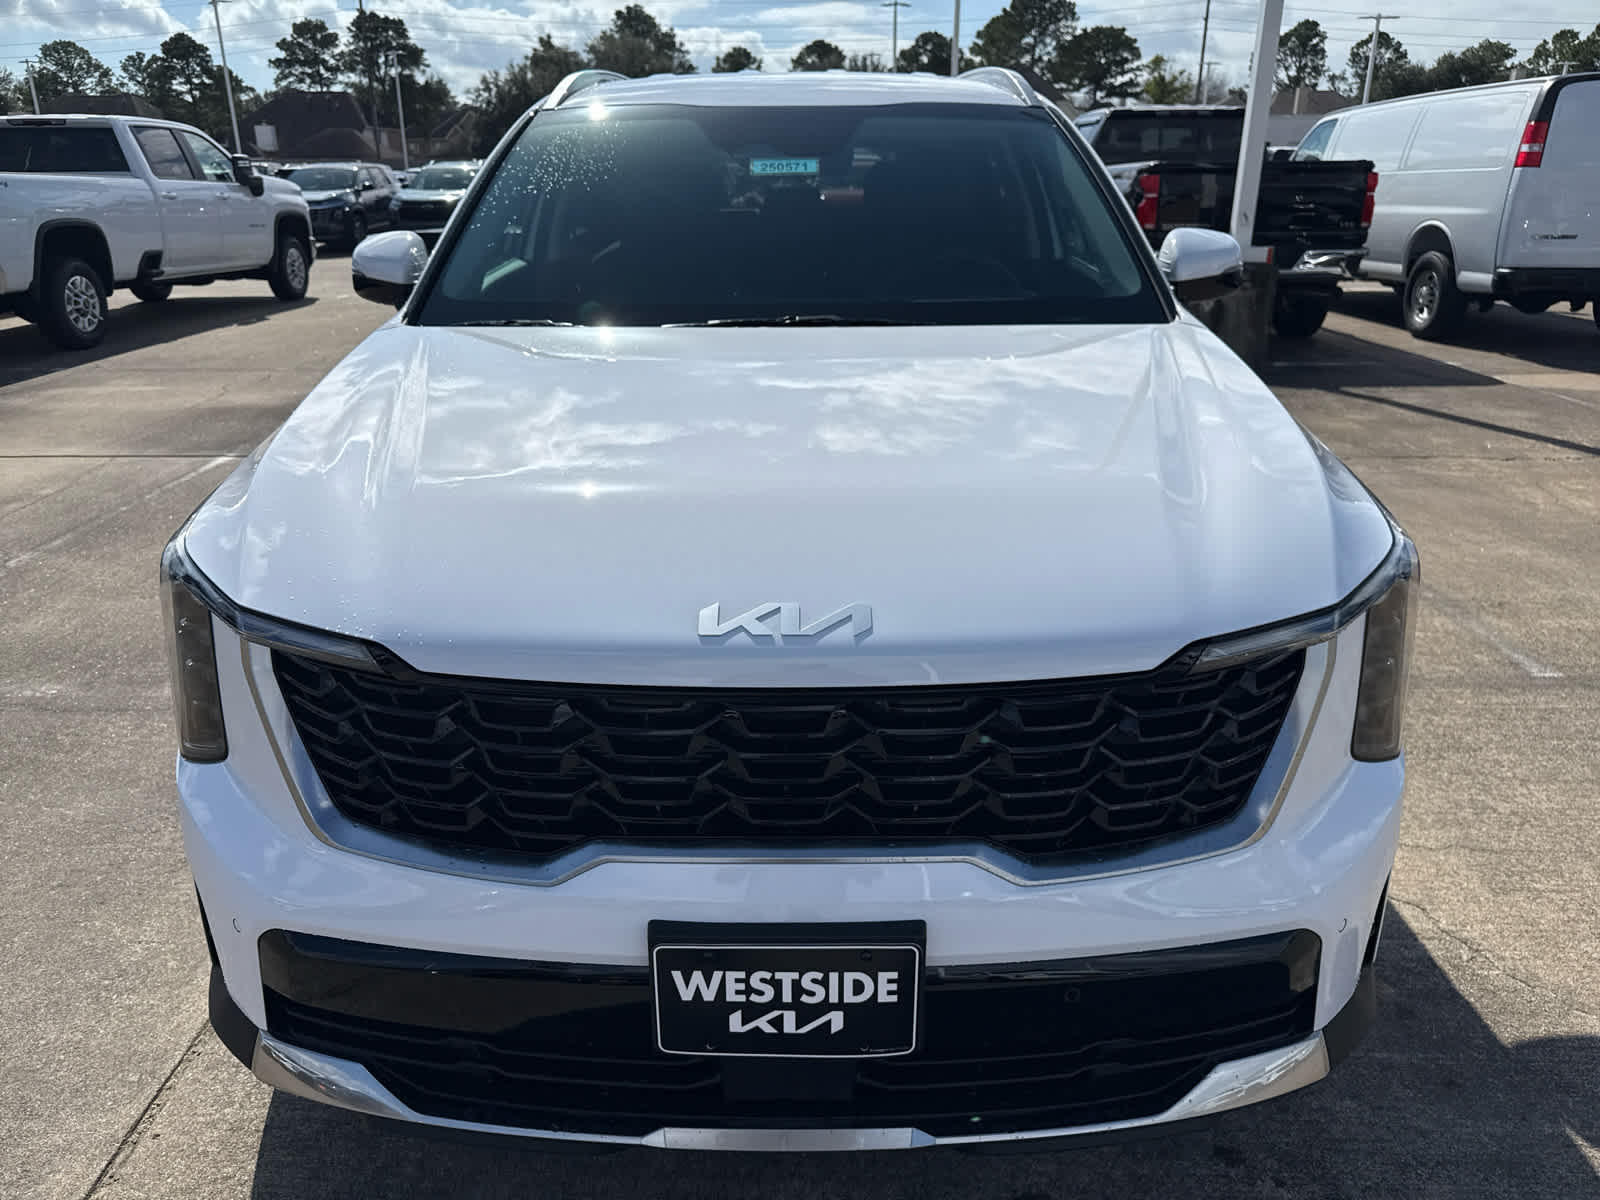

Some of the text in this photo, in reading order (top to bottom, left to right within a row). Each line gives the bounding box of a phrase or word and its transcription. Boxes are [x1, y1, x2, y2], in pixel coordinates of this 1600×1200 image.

[759, 161, 808, 172] 250571
[698, 601, 874, 639] KIA
[671, 970, 900, 1004] WESTSIDE
[728, 1009, 845, 1035] KIA
